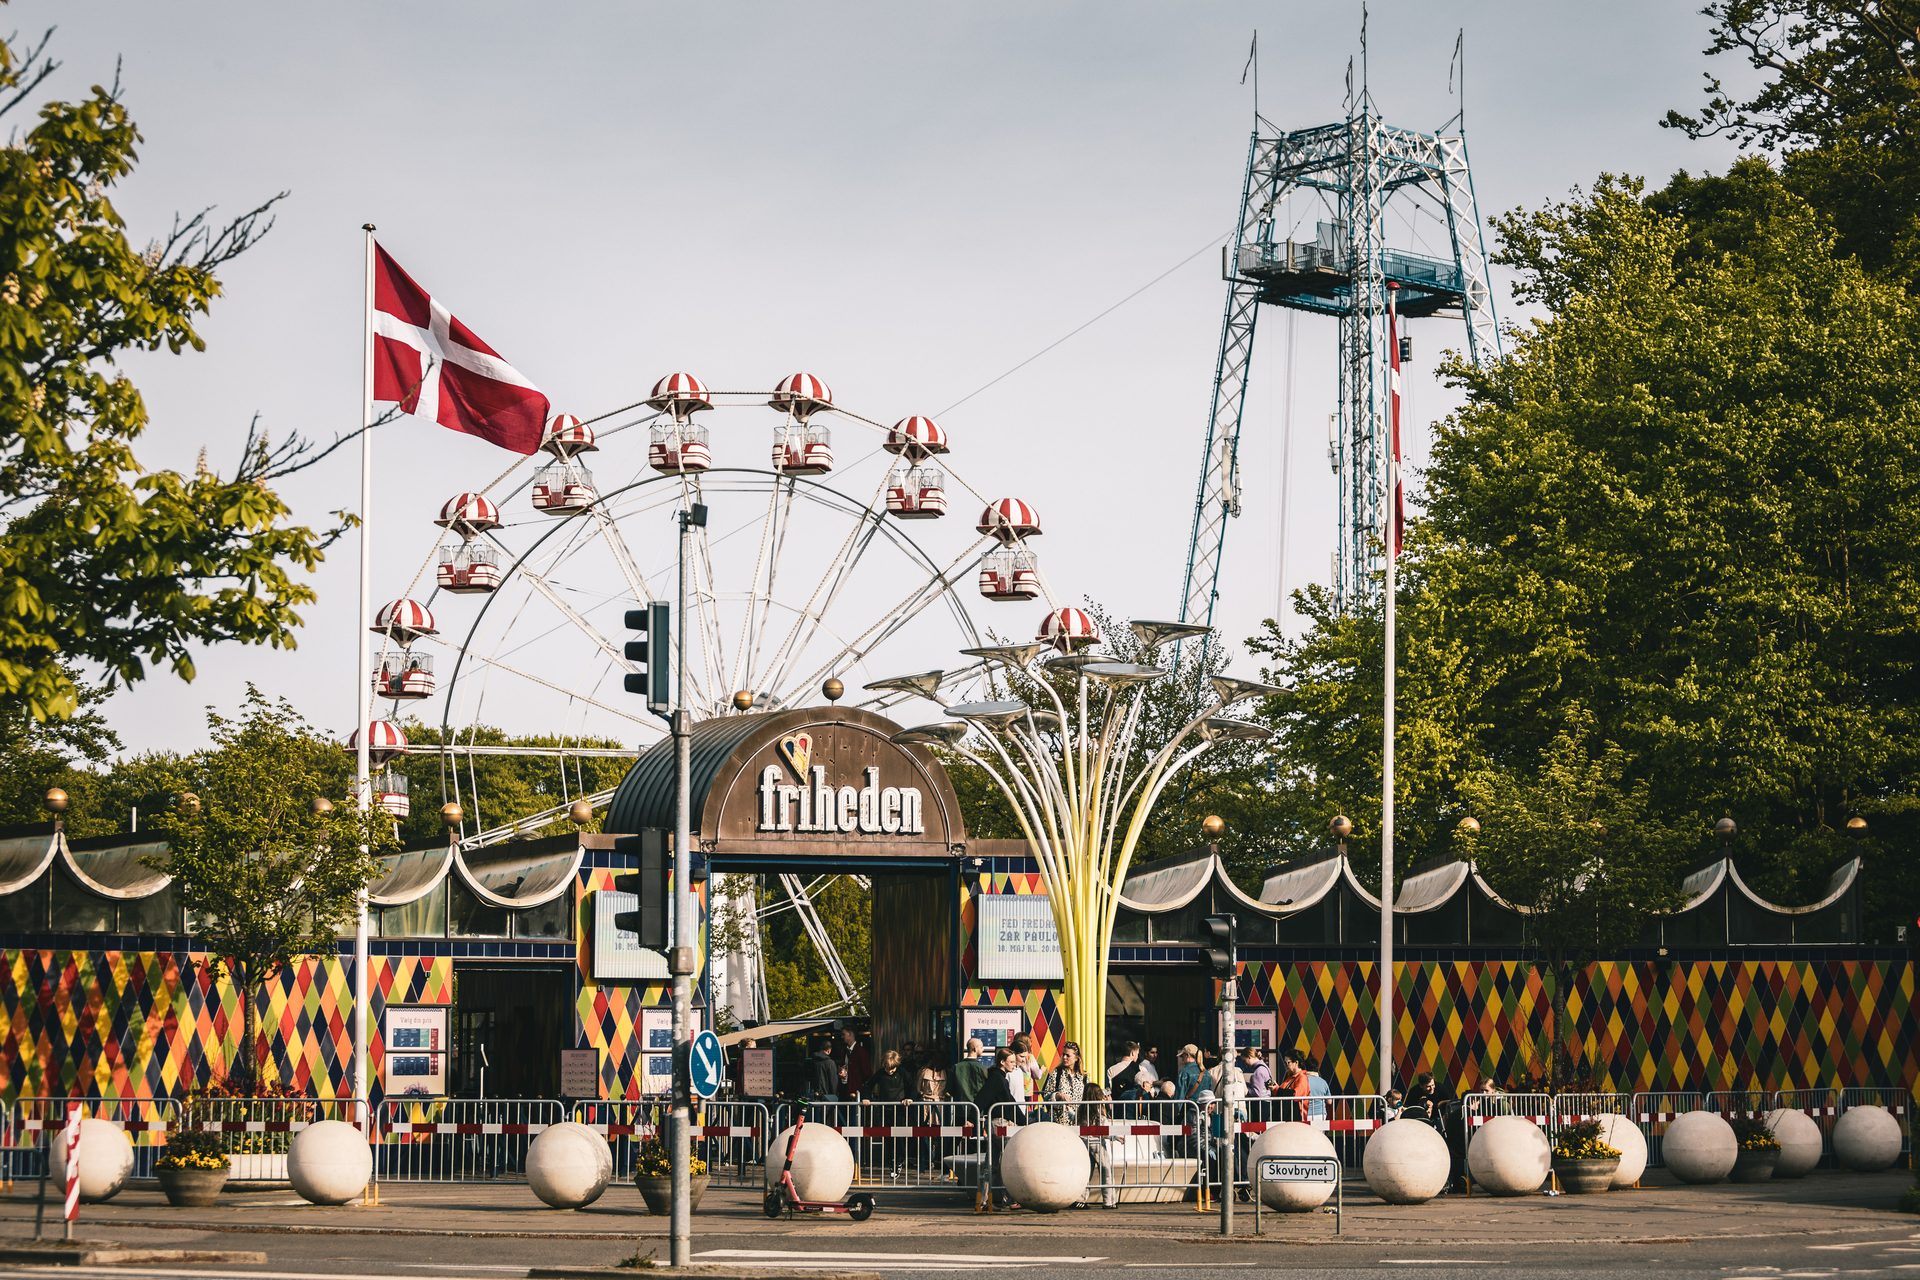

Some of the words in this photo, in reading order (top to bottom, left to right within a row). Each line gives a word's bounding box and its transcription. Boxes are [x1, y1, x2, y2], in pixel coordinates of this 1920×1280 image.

[760, 764, 925, 833] friheden
[1001, 918, 1018, 929] FED
[1000, 931, 1020, 941] ZAR
[1024, 931, 1058, 941] PAULO
[1010, 944, 1025, 952] MAJ
[1269, 1164, 1328, 1179] Skovbrynet
